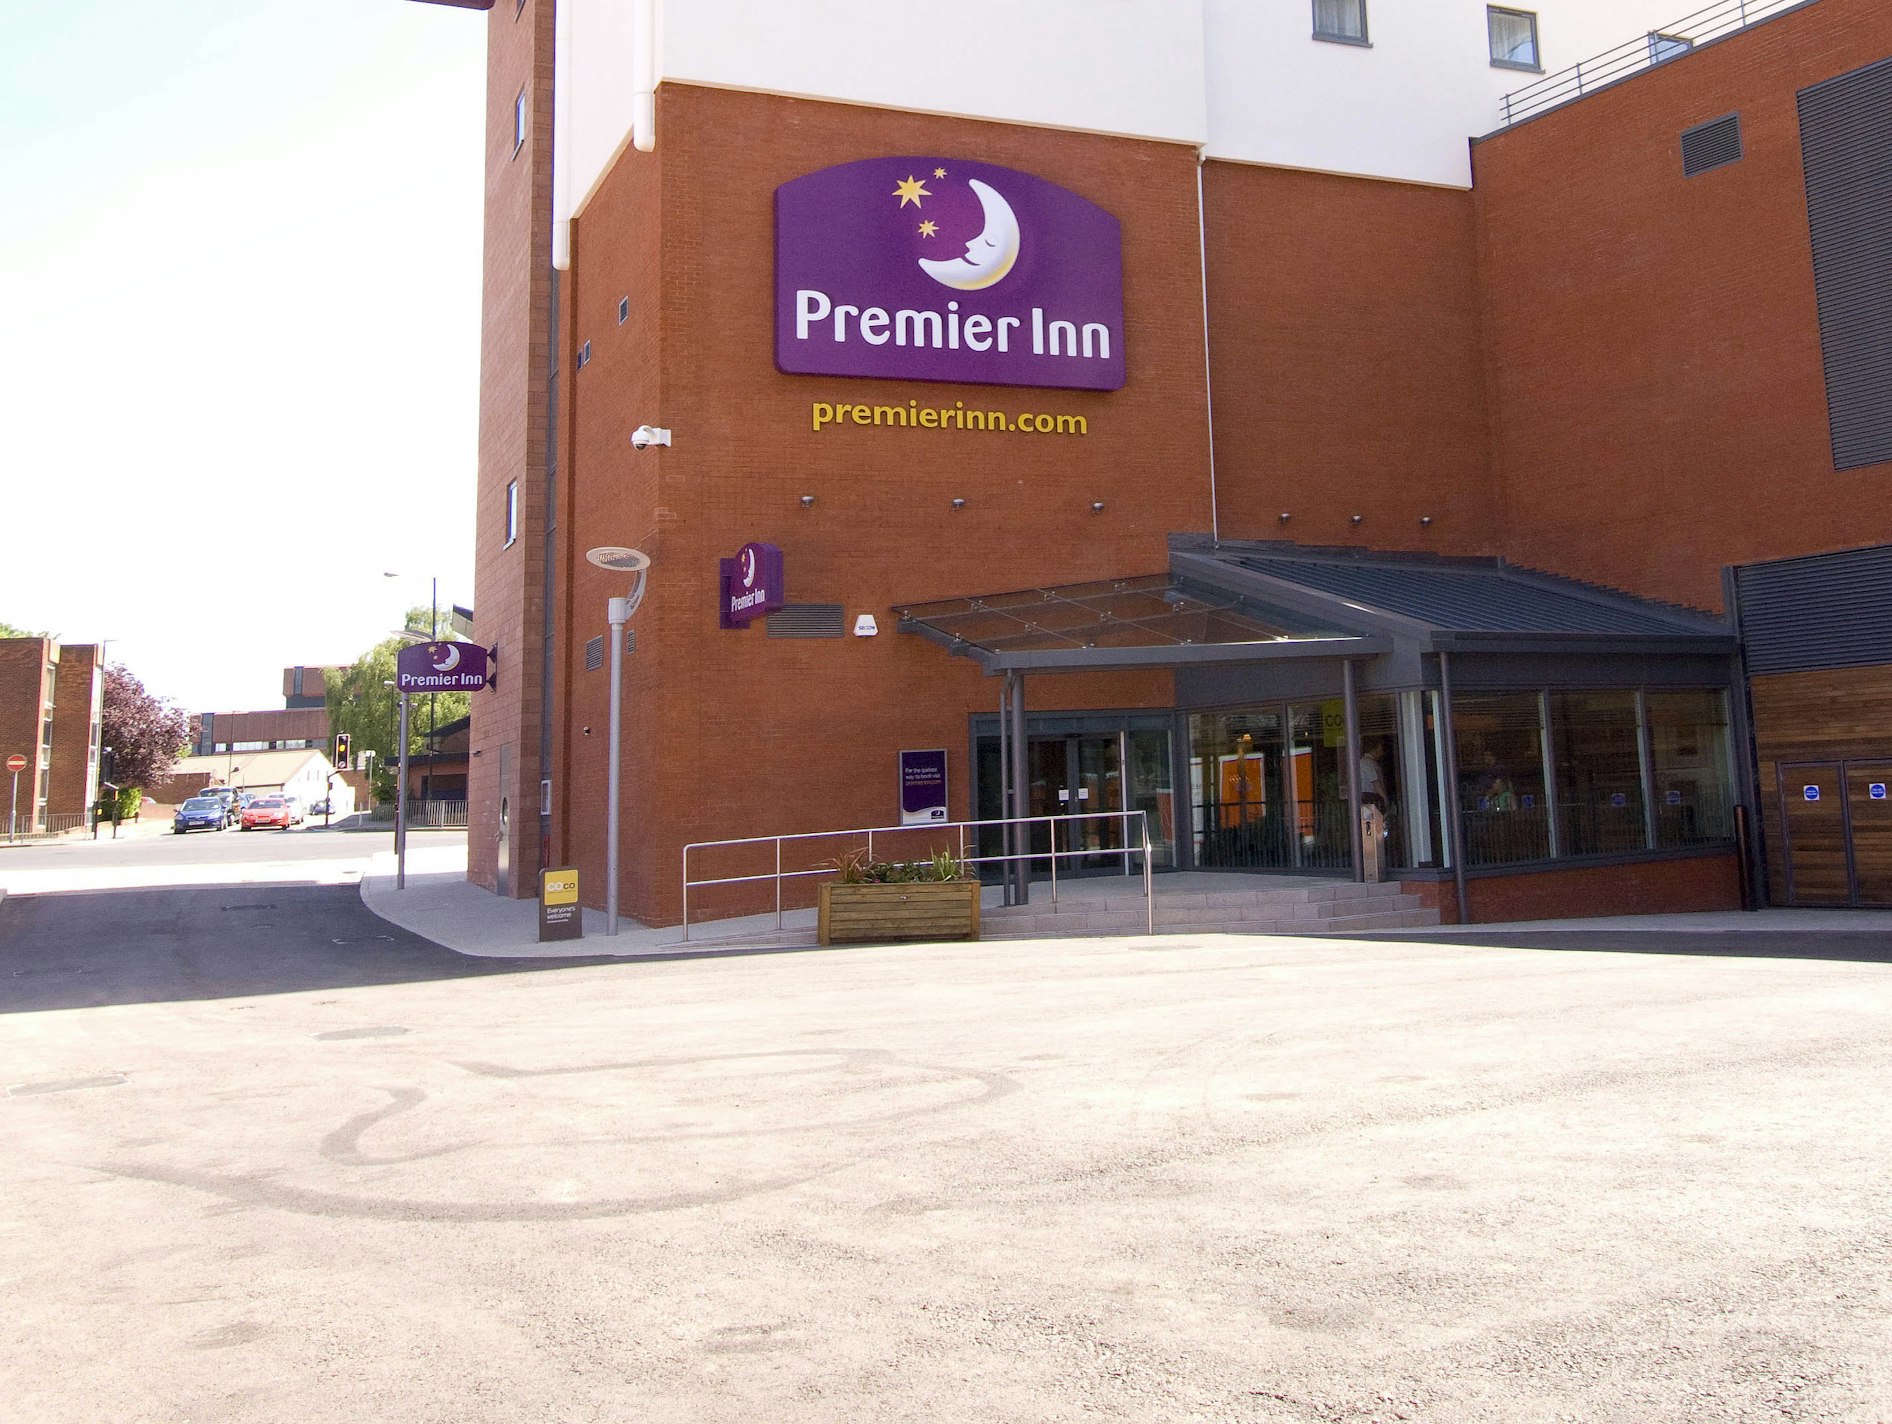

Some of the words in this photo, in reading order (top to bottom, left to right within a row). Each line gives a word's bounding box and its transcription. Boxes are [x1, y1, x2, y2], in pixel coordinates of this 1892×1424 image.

[795, 289, 1020, 353] Premier
[1031, 307, 1110, 359] Inn
[812, 400, 1088, 434] premierinn.com
[731, 591, 755, 612] Premier
[755, 588, 766, 605] Inn
[401, 673, 458, 686] Premier
[461, 673, 483, 685] Inn
